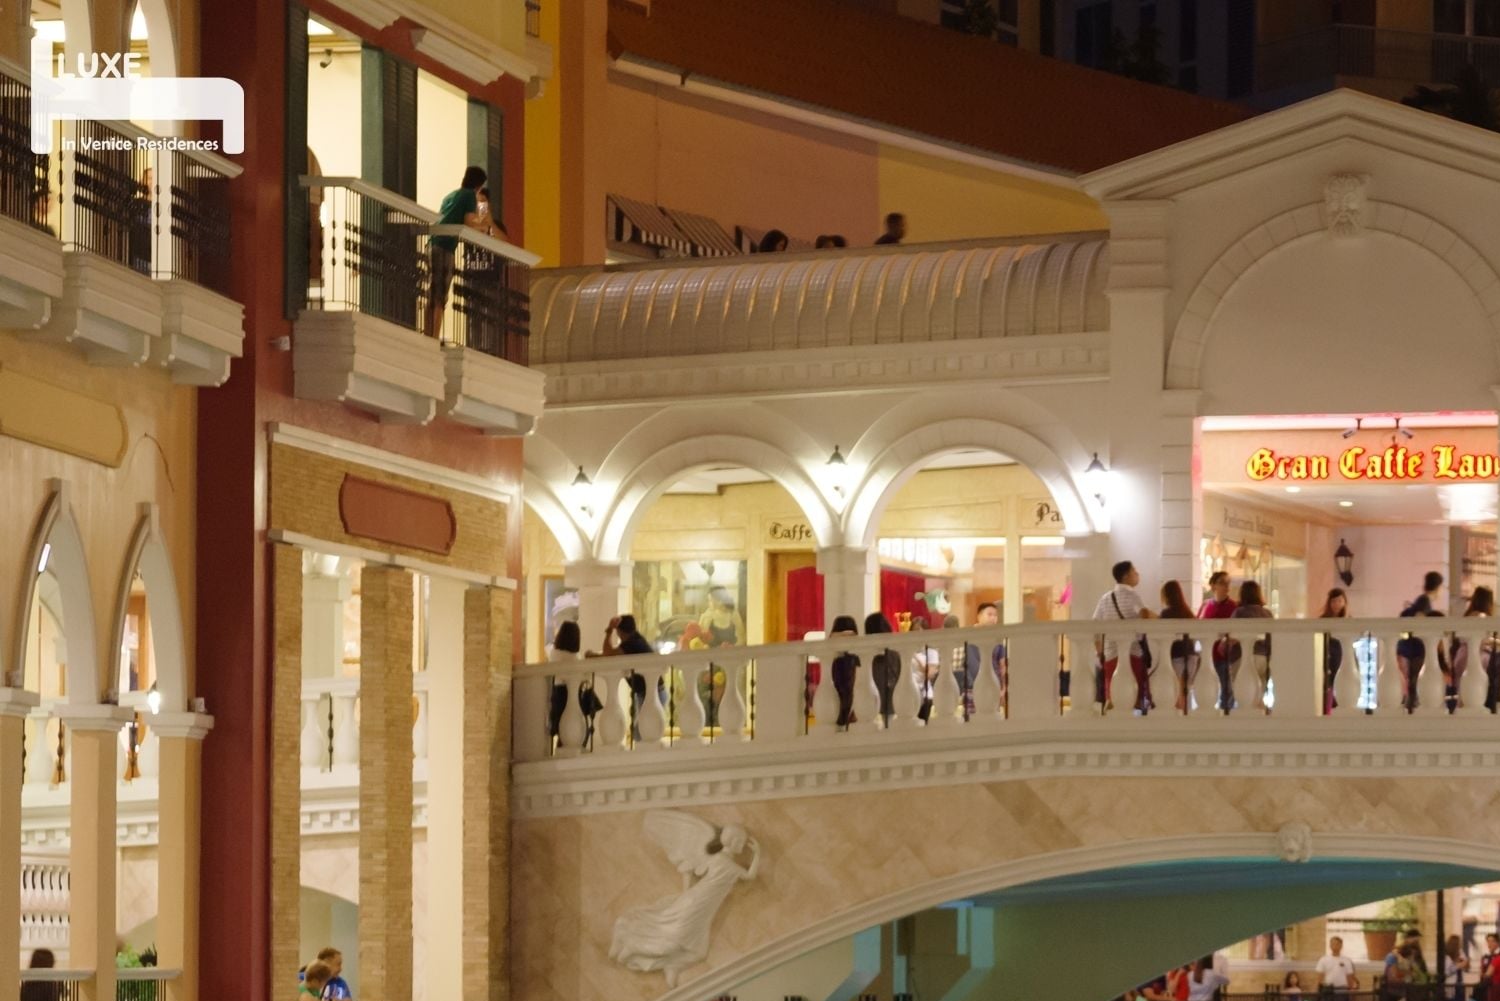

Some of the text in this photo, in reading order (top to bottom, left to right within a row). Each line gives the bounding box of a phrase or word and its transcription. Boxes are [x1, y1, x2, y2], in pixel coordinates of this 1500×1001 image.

[1246, 448, 1329, 480] Gran
[1339, 446, 1425, 480] Caffe
[1034, 502, 1063, 526] Pa
